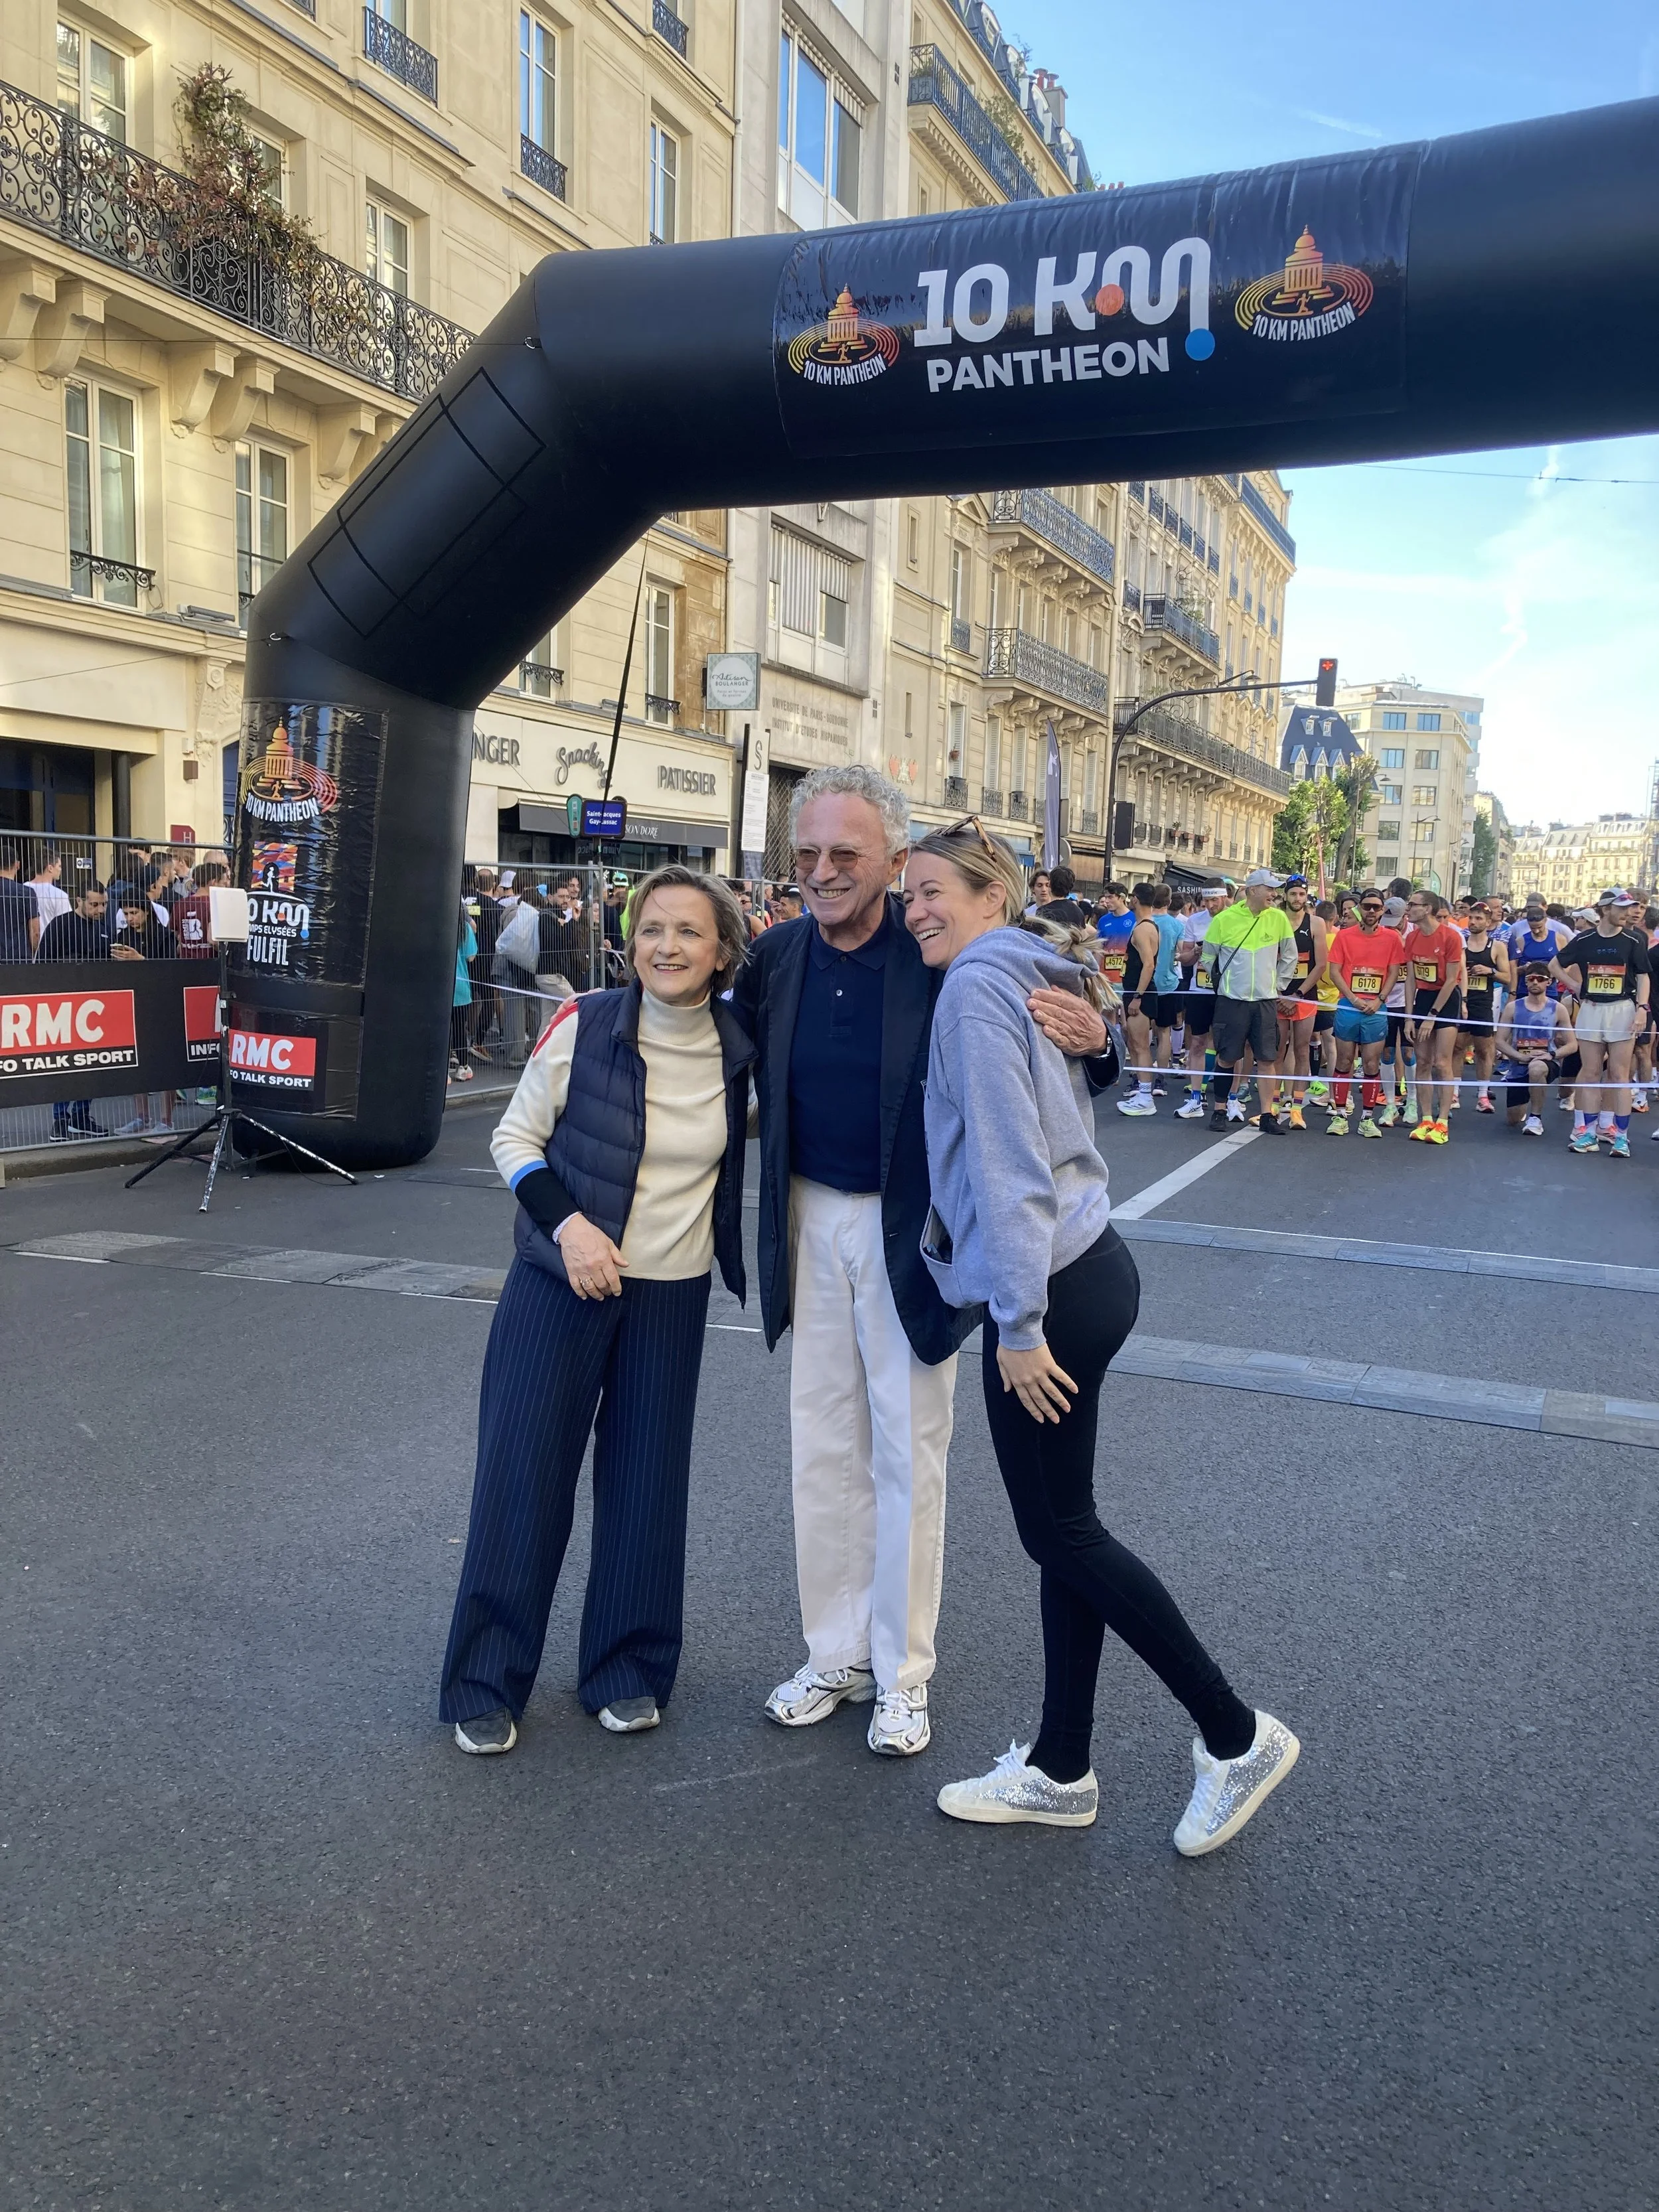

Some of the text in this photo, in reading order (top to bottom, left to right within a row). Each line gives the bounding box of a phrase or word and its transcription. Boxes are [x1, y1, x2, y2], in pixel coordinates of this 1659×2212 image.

[914, 236, 1212, 347] 10 KM
[1253, 301, 1356, 342] 10 KM PANTHEON
[804, 353, 887, 386] 10 KM PANTHEON
[927, 336, 1170, 393] PANTHEON
[711, 673, 753, 682] Artisan
[802, 705, 808, 717] DE
[772, 717, 793, 733] INSTITUT
[820, 730, 848, 747] HISPANIQUES
[657, 765, 717, 796] PATISSIER
[246, 792, 319, 822] 10 KM PANTHEON
[262, 900, 309, 930] KM
[264, 925, 297, 937] ELYSÉES
[247, 934, 289, 966] FULFIL
[1108, 957, 1122, 966] 4572
[1358, 978, 1376, 988] 6178
[1595, 978, 1615, 989] 1766
[1, 999, 105, 1049] RMC
[22, 1055, 70, 1070] TALK
[73, 1050, 133, 1066] SPORT
[190, 1043, 220, 1056] INF
[231, 1033, 294, 1070] RMC
[240, 1072, 265, 1083] TALK
[268, 1076, 312, 1088] SPORT
